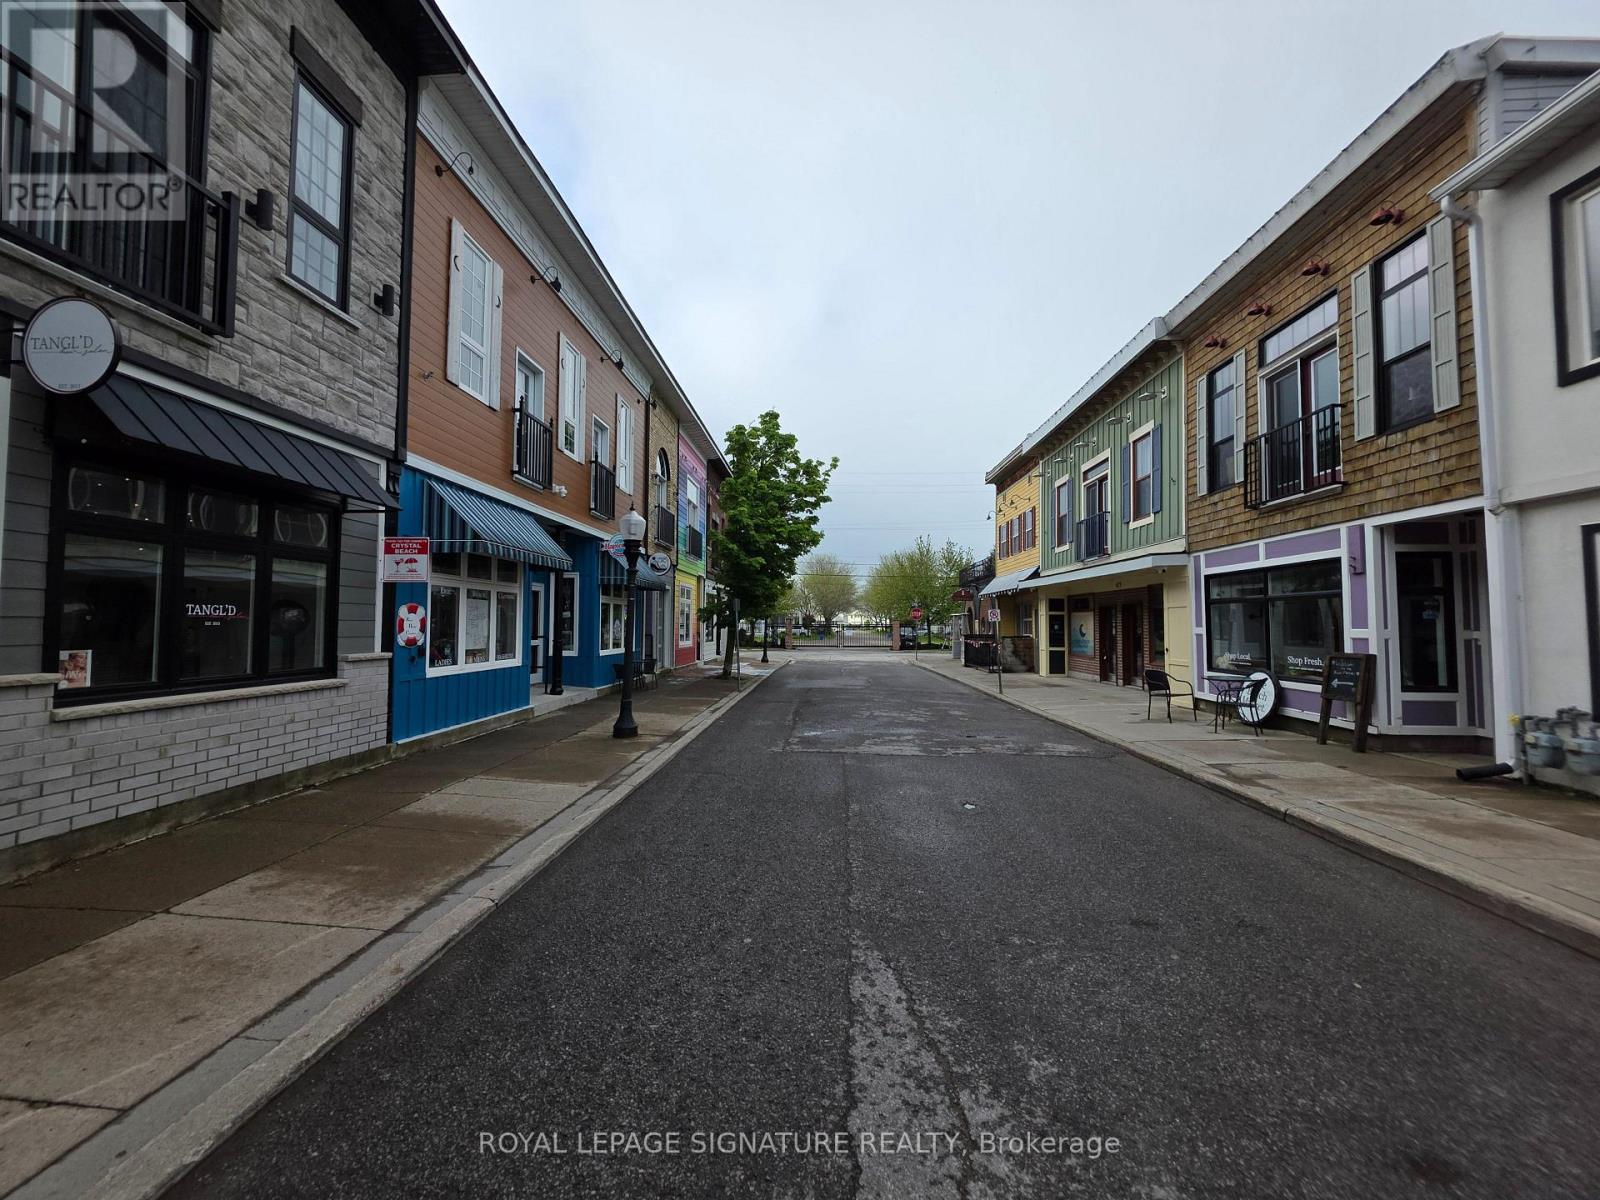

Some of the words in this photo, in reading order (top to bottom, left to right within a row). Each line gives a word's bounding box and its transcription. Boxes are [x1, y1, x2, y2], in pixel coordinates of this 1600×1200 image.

[30, 335, 94, 350] TANGL'D
[185, 603, 237, 616] TANGL'D
[434, 658, 453, 667] LADIES
[1287, 655, 1303, 666] Shop
